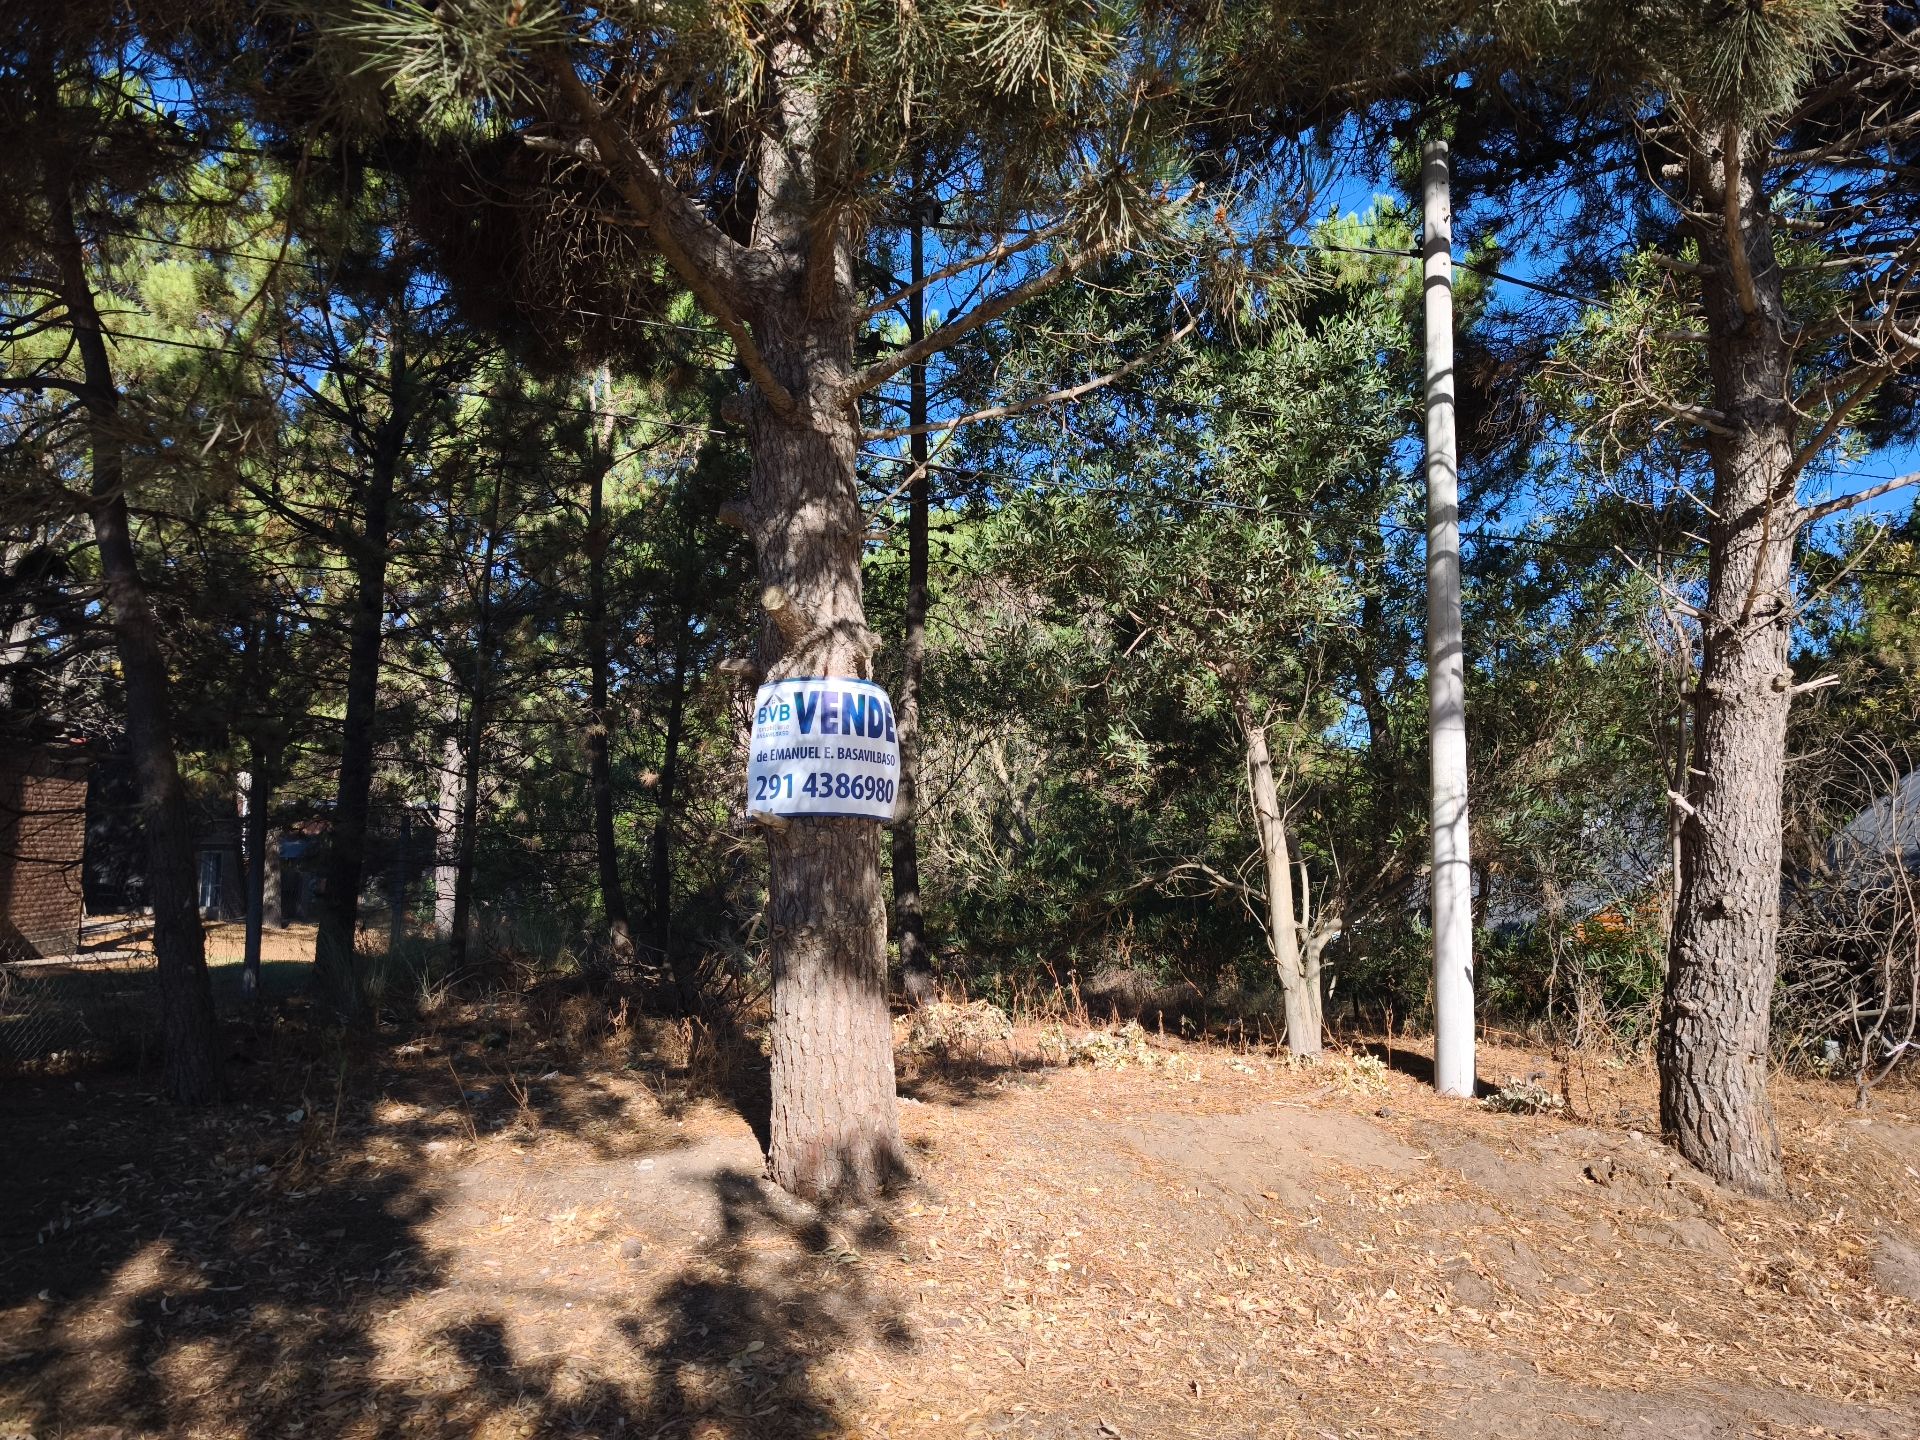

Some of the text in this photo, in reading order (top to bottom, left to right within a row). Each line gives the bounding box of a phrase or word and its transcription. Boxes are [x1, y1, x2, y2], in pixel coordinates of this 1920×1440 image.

[758, 704, 790, 724] BVB
[794, 691, 895, 743] VENDE
[757, 747, 895, 767] de EMANUEL E. BASAVILBASO
[756, 773, 894, 803] 291 4386980
